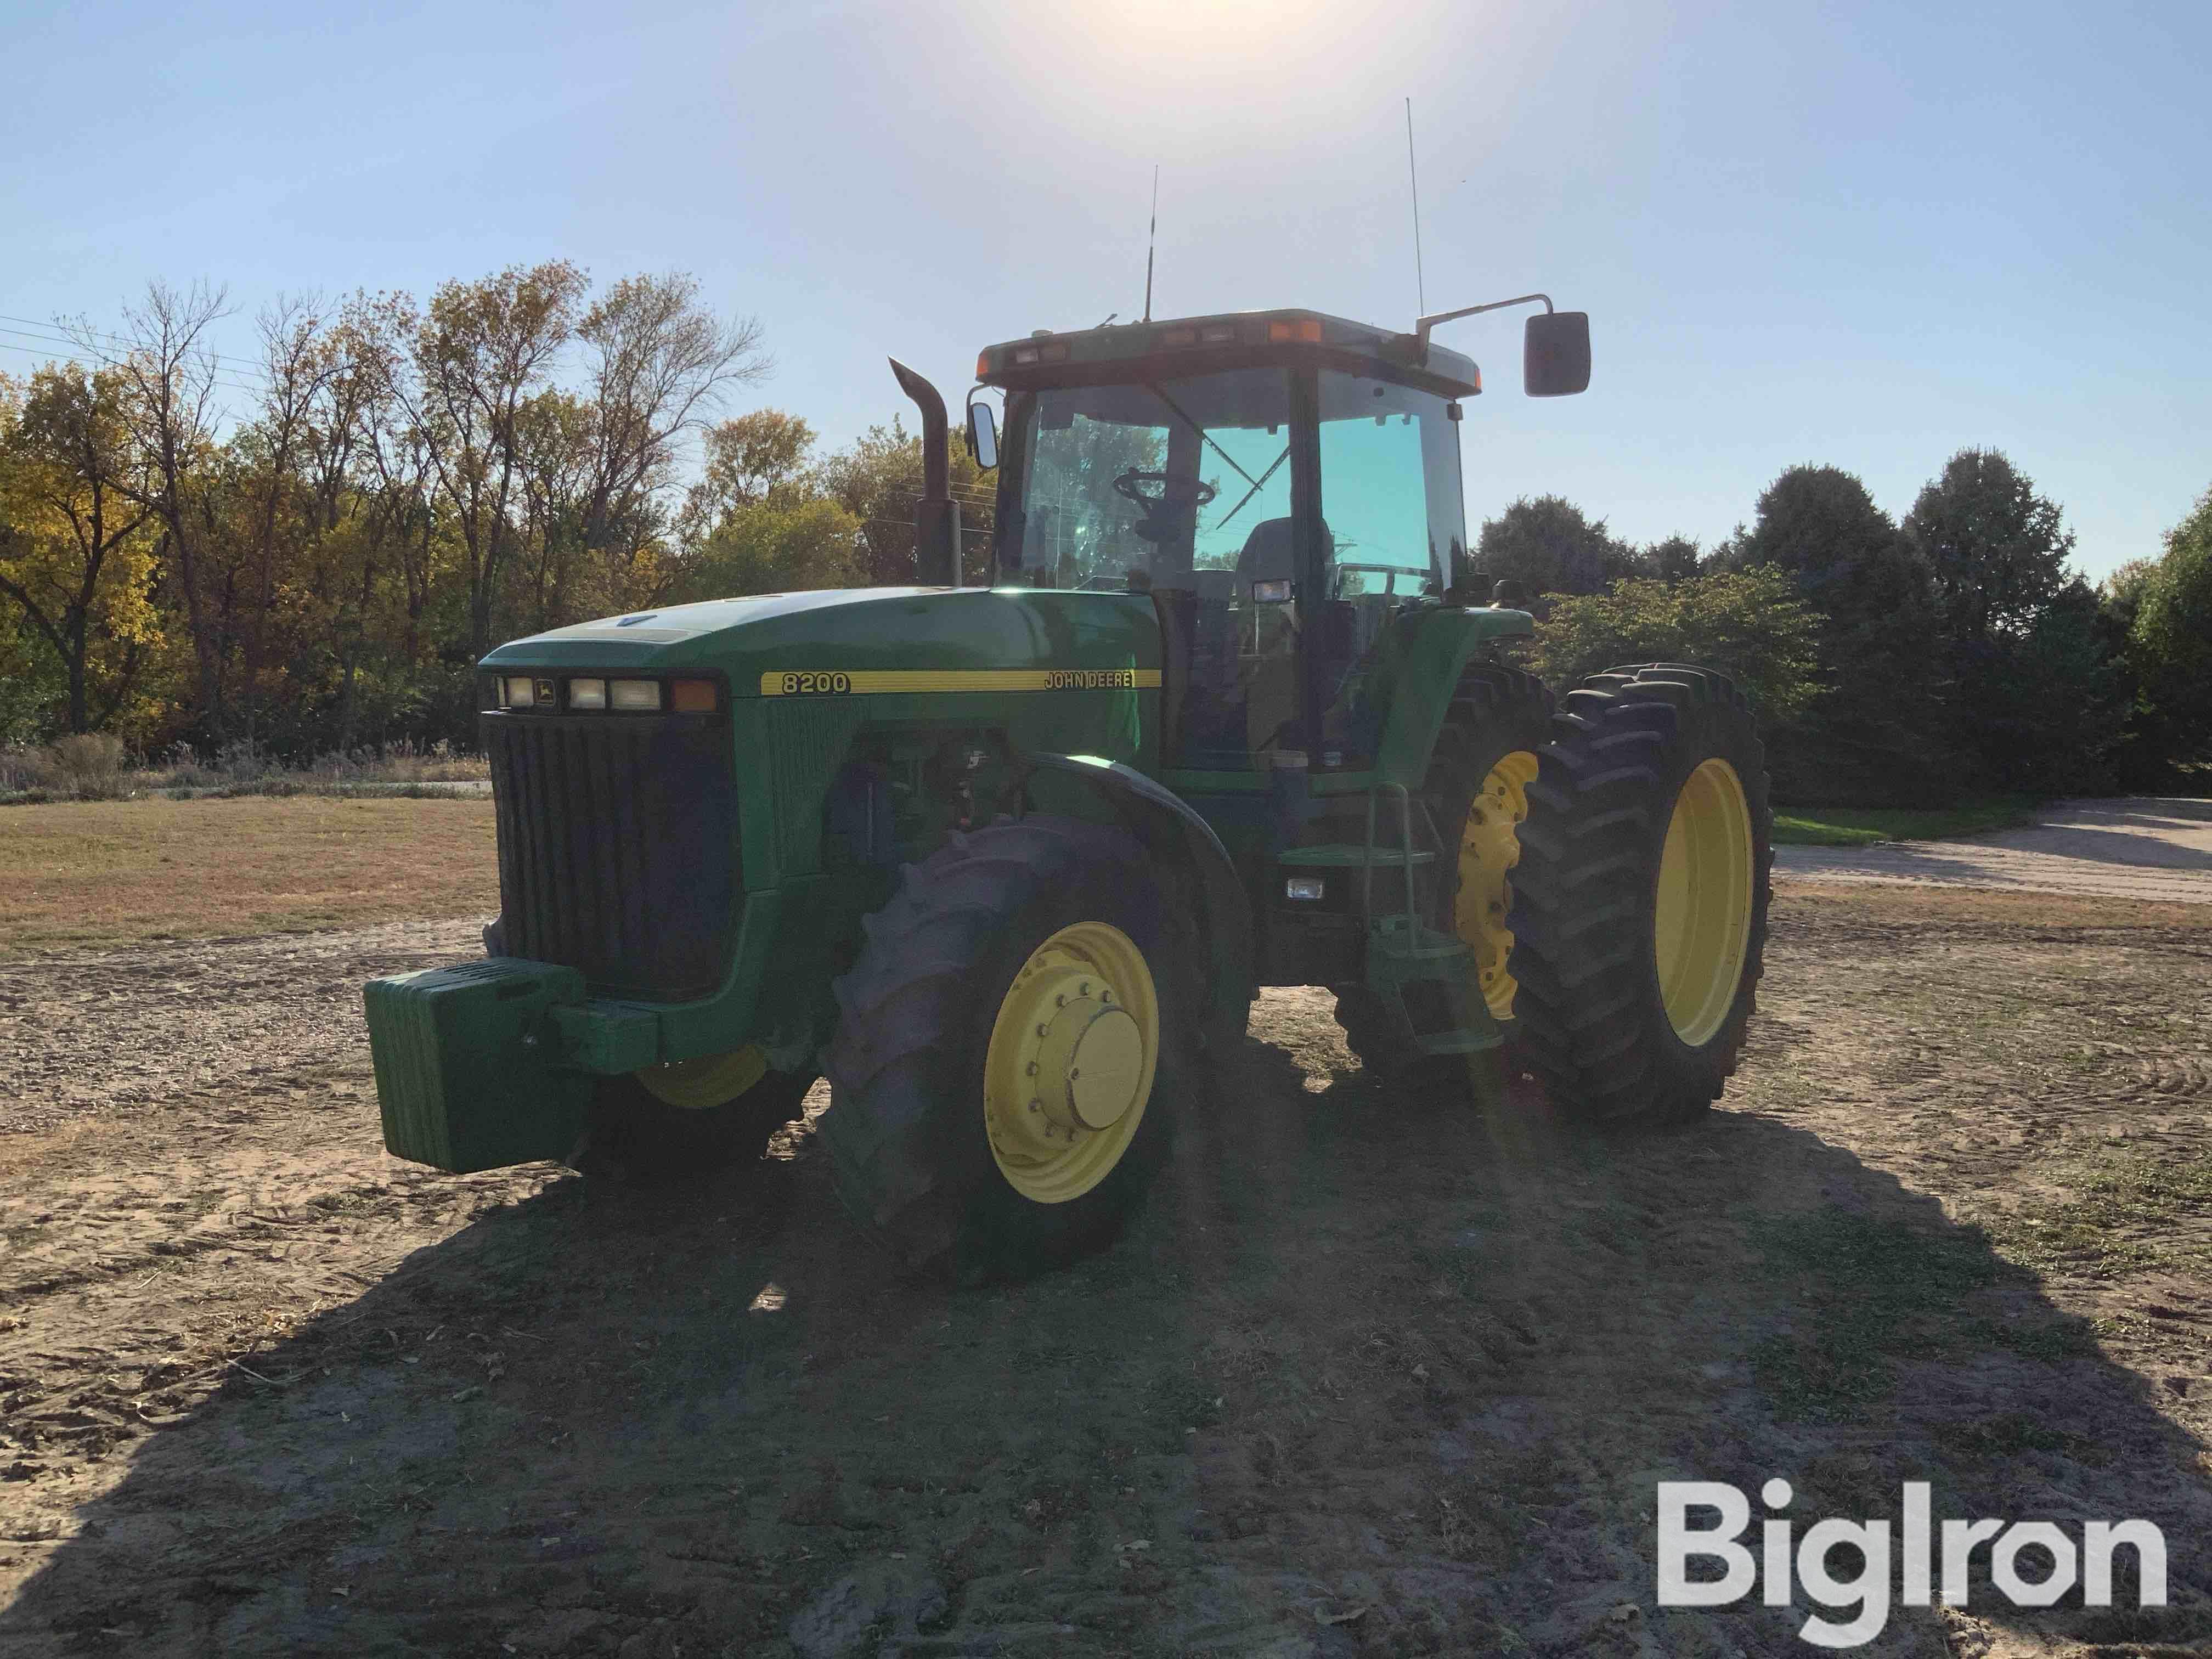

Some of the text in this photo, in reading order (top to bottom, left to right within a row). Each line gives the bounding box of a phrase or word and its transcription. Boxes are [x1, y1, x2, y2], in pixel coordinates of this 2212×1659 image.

[782, 673, 850, 693] 8200
[1045, 671, 1132, 690] JOHN DEERE
